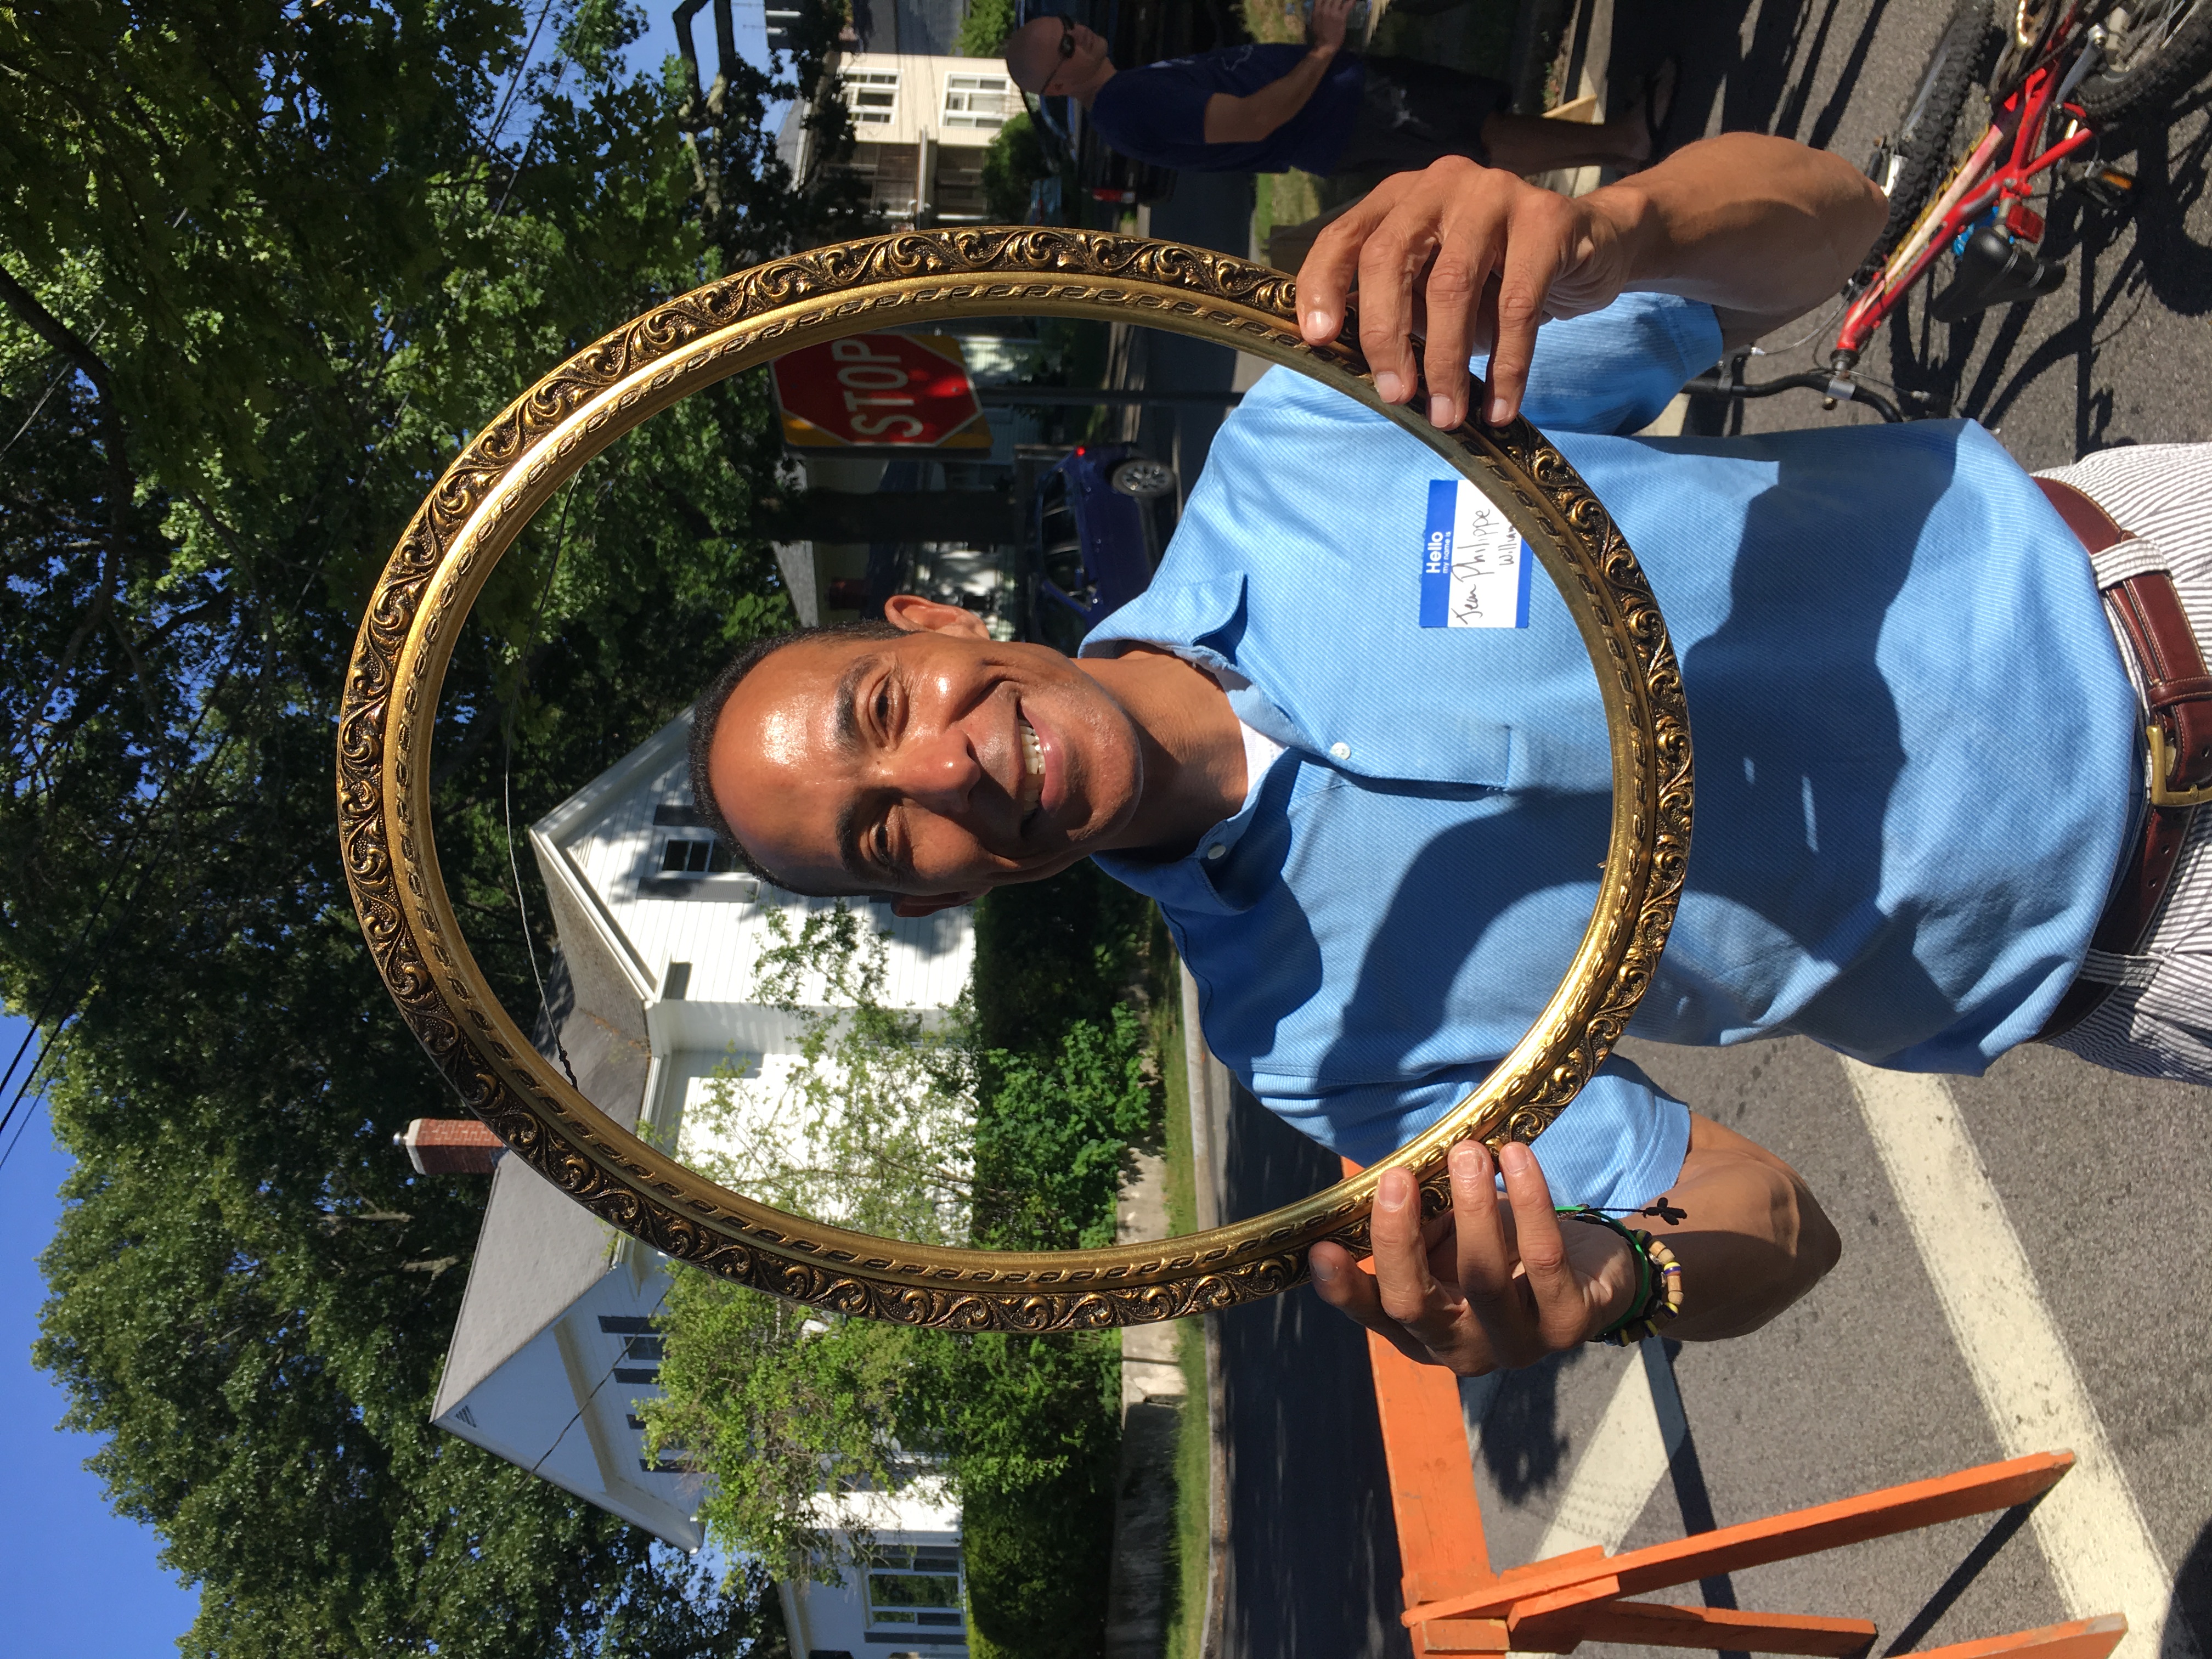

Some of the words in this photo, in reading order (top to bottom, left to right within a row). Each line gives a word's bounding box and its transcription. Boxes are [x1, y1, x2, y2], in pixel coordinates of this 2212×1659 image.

[831, 339, 923, 438] STOP
[1426, 532, 1443, 573] Hello
[1451, 509, 1499, 582] Philippe
[1443, 562, 1449, 573] my
[1451, 584, 1483, 624] Jean
